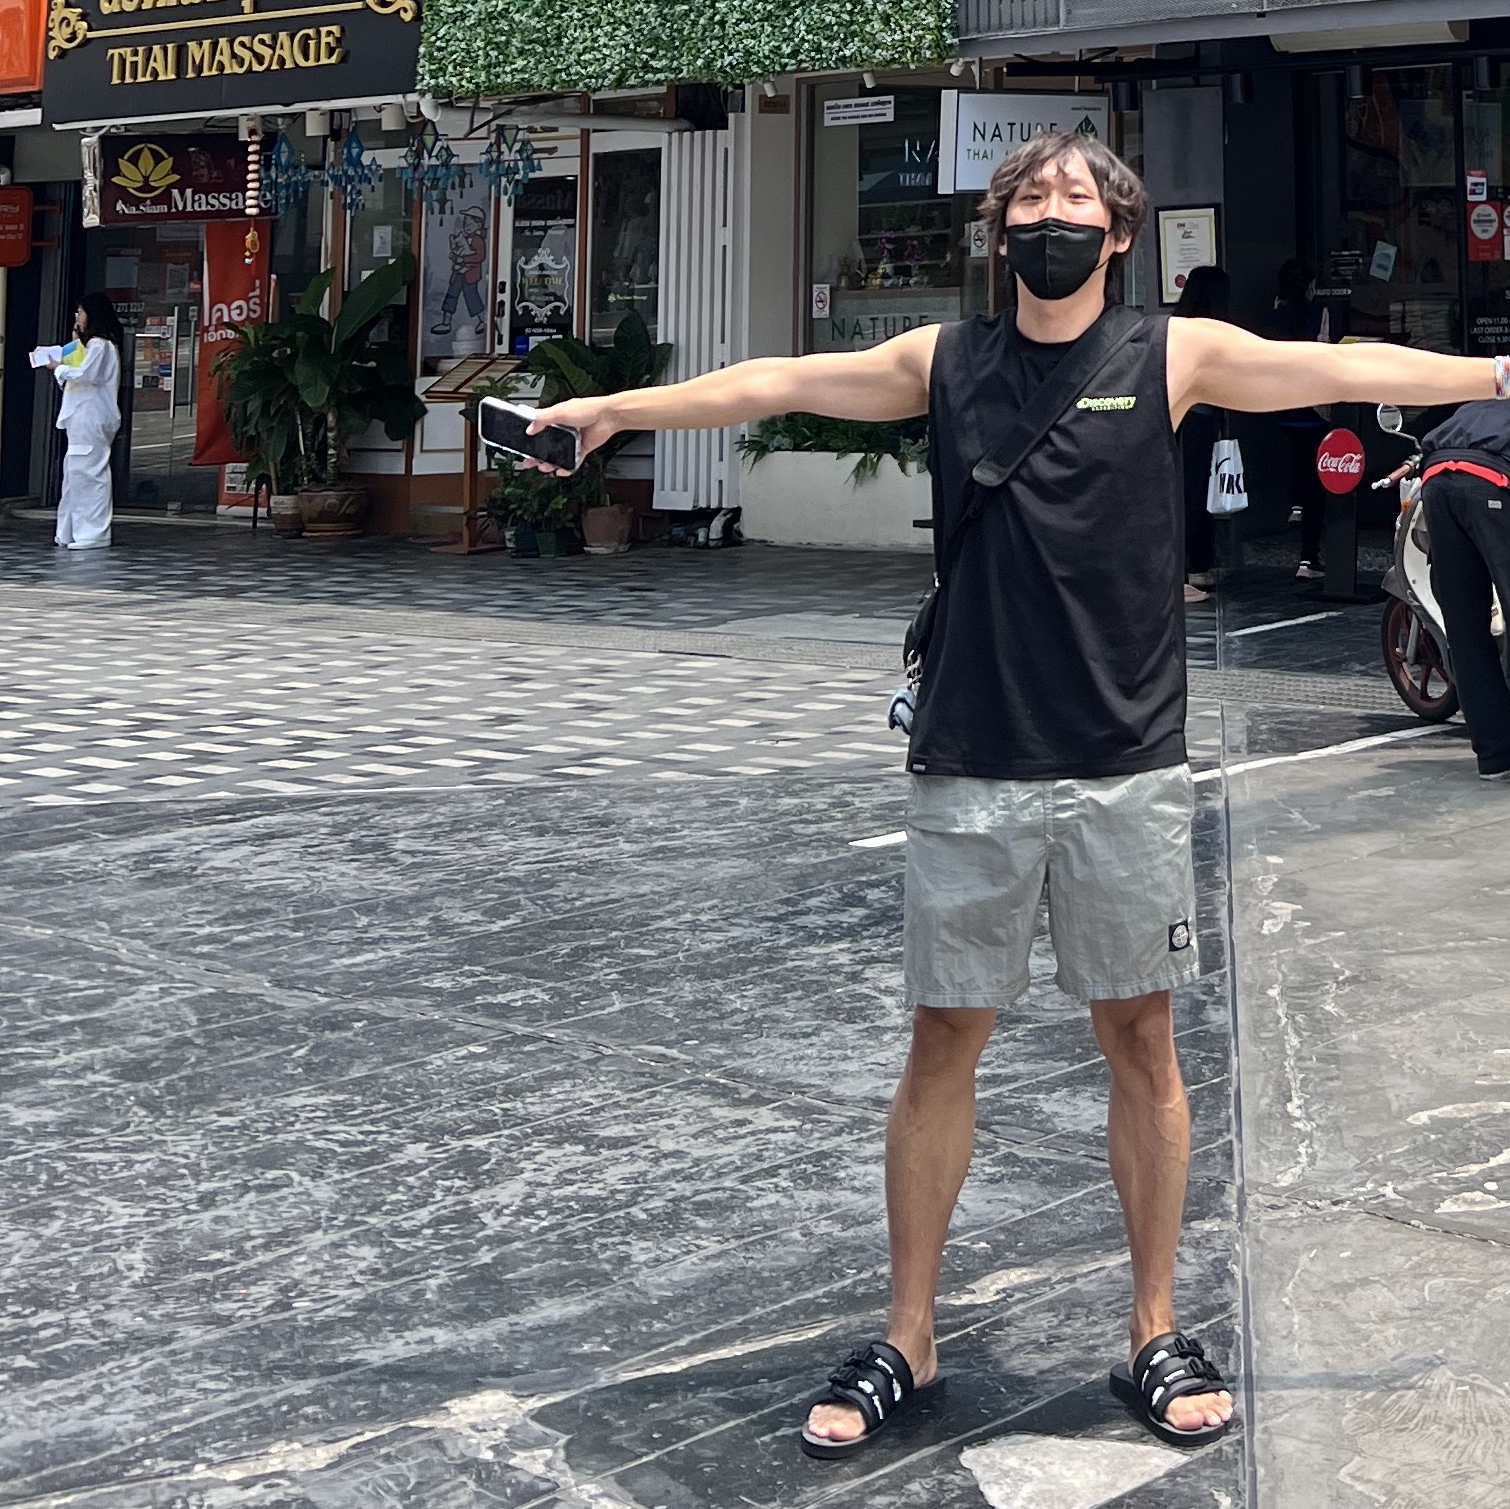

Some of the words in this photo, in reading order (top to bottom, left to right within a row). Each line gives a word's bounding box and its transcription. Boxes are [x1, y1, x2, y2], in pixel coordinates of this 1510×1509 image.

[107, 42, 178, 85] THAI
[185, 25, 344, 79] MASSAGE
[972, 121, 1058, 143] NATU
[966, 148, 994, 161] THAI
[170, 188, 273, 213] Massae
[1476, 317, 1493, 325] OPEN
